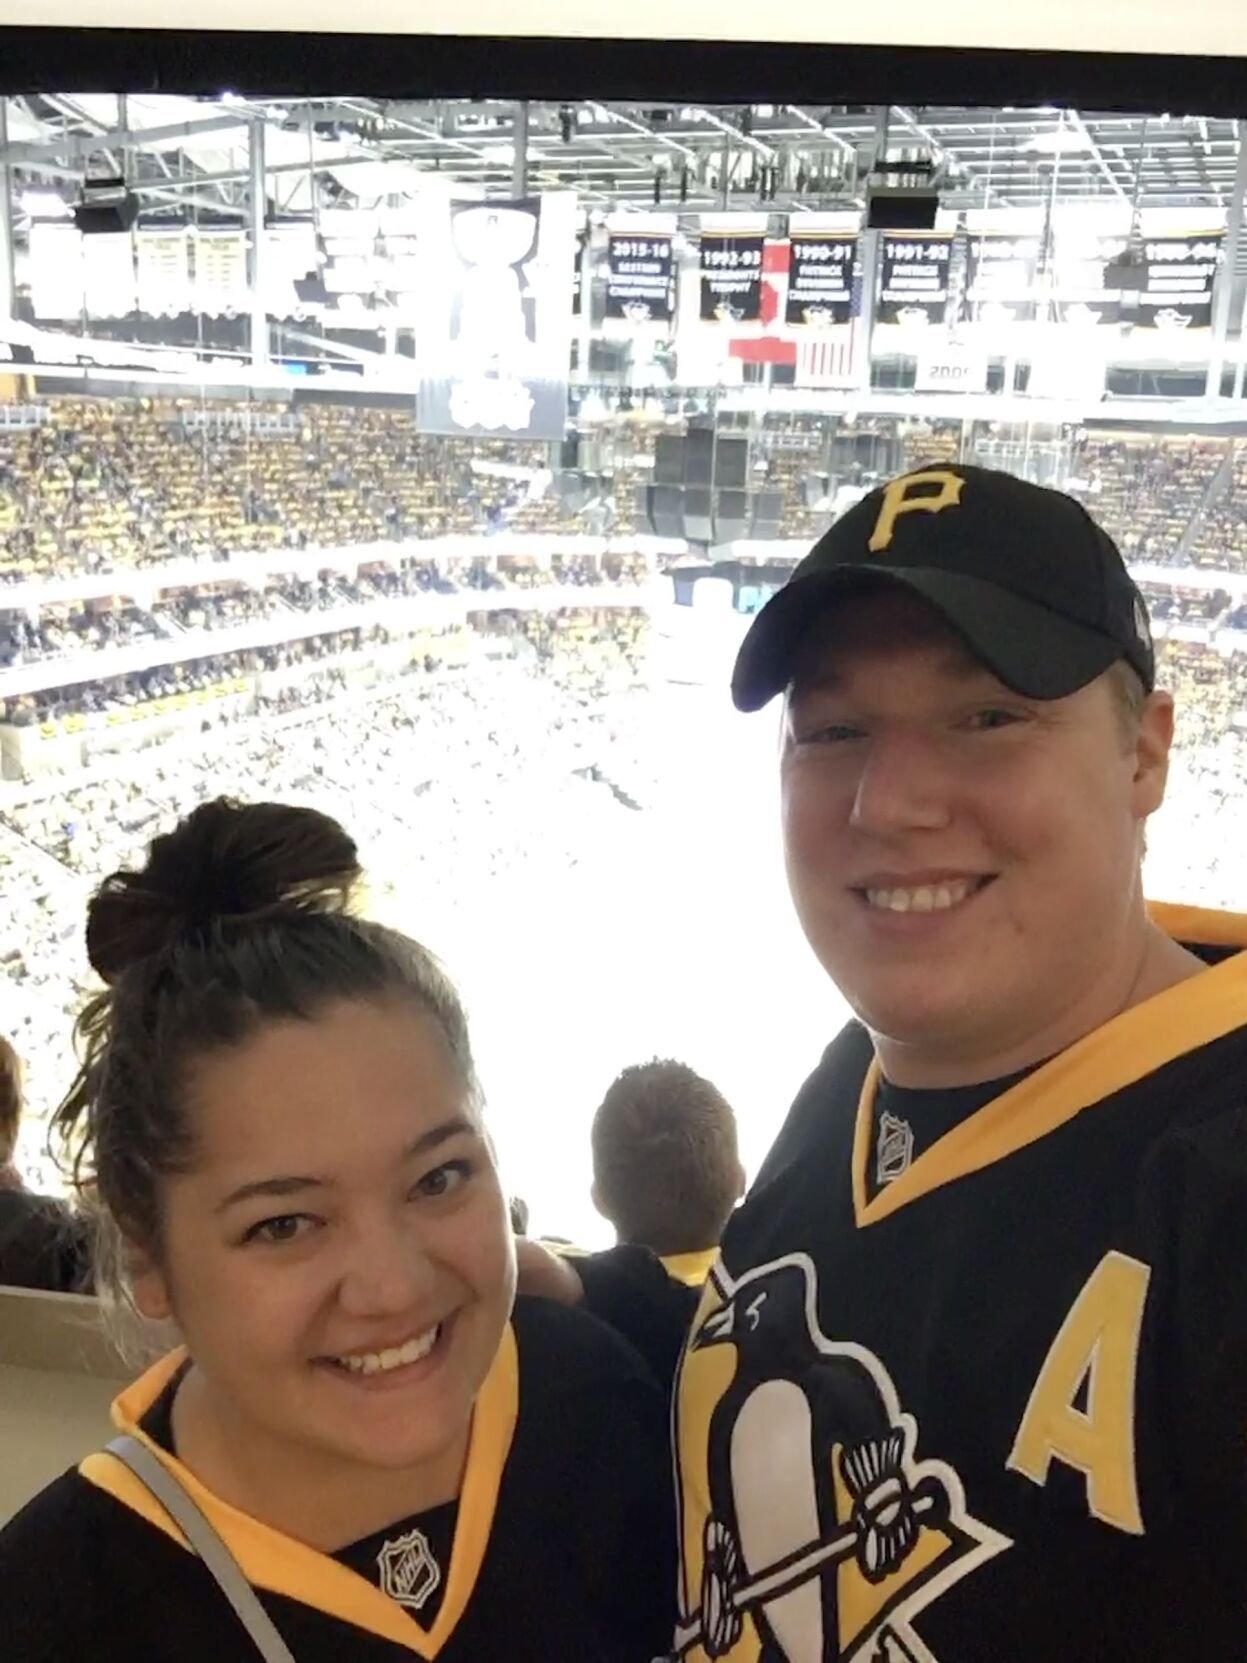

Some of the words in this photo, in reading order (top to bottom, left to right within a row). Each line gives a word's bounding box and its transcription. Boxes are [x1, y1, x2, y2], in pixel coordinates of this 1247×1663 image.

[613, 242, 669, 258] 2015-16
[704, 250, 761, 266] 1992-93
[868, 470, 967, 552] P
[1005, 1249, 1152, 1536] A
